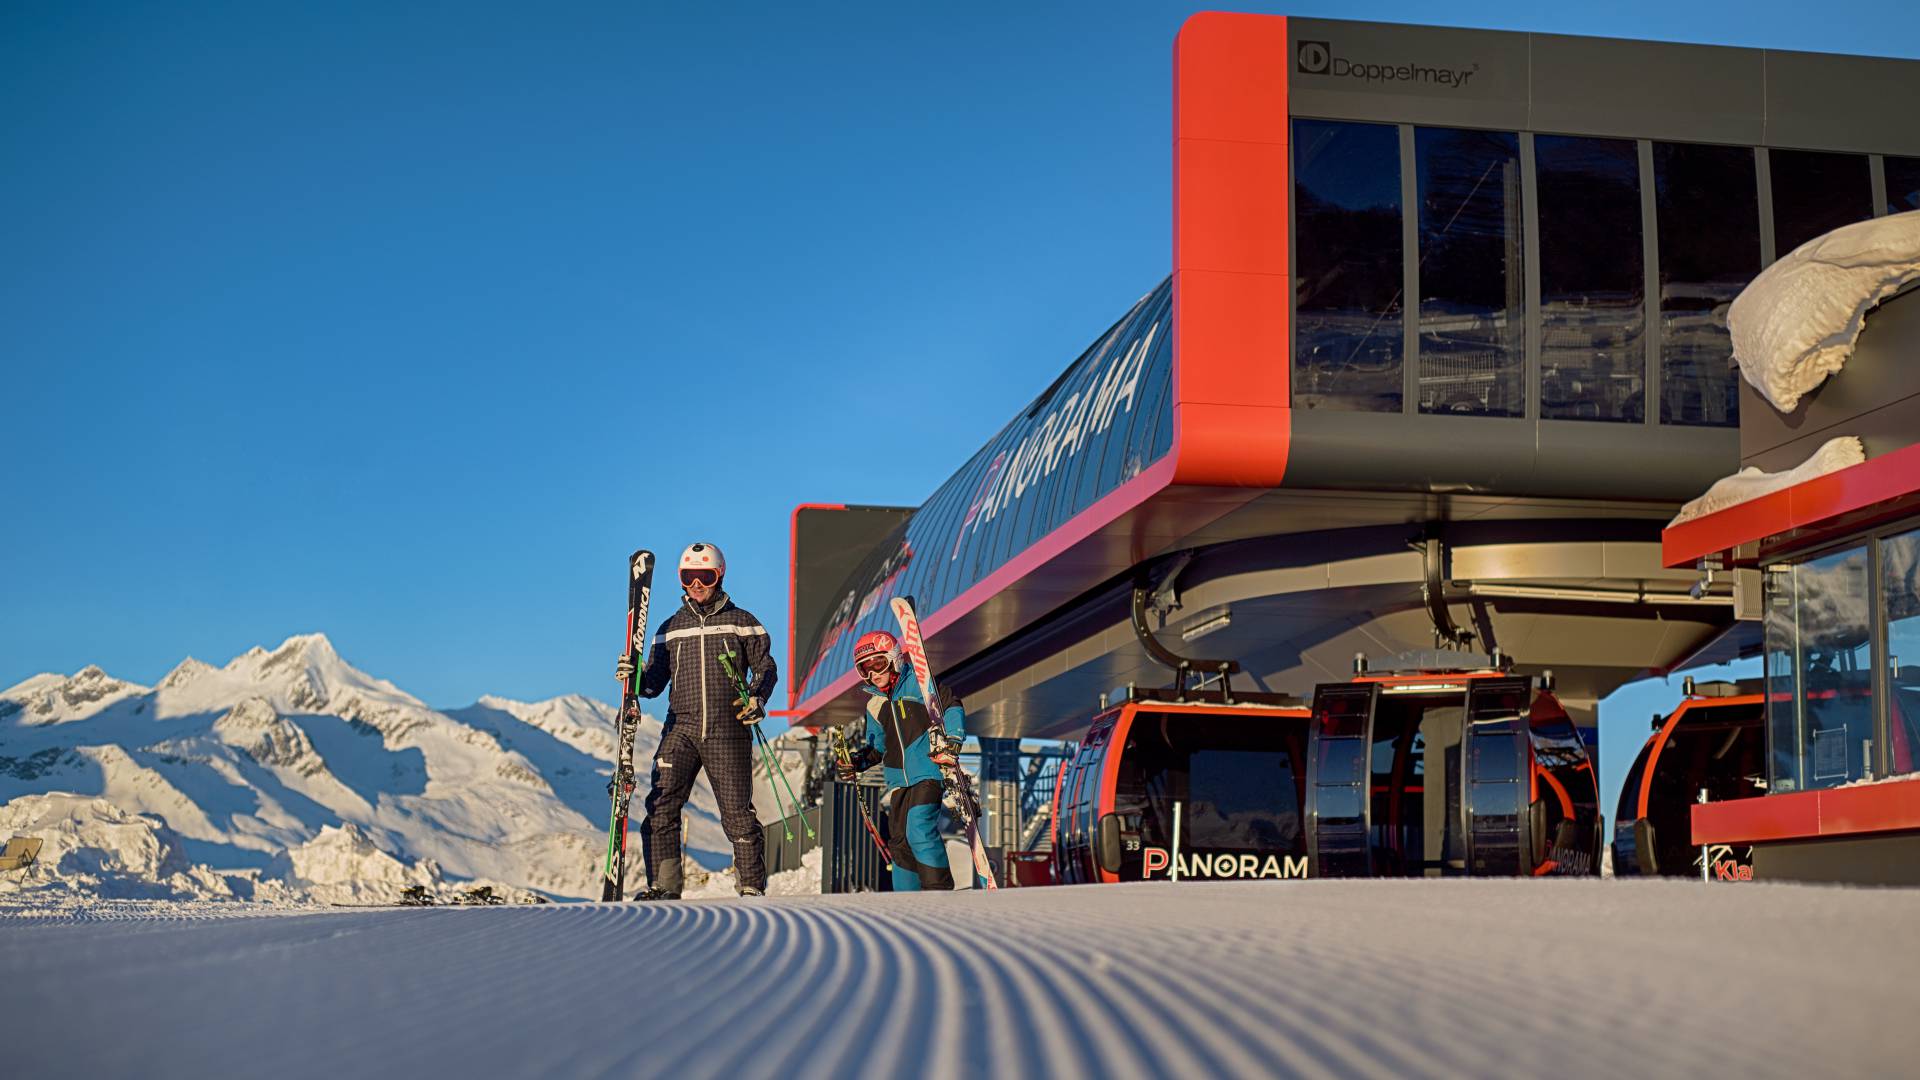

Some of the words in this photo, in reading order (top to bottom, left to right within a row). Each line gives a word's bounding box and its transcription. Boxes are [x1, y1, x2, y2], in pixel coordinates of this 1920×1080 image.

[952, 322, 1159, 561] PANORAMA
[634, 586, 650, 653] NORDICA
[1126, 841, 1140, 851] 33
[1716, 860, 1754, 880] Kla
